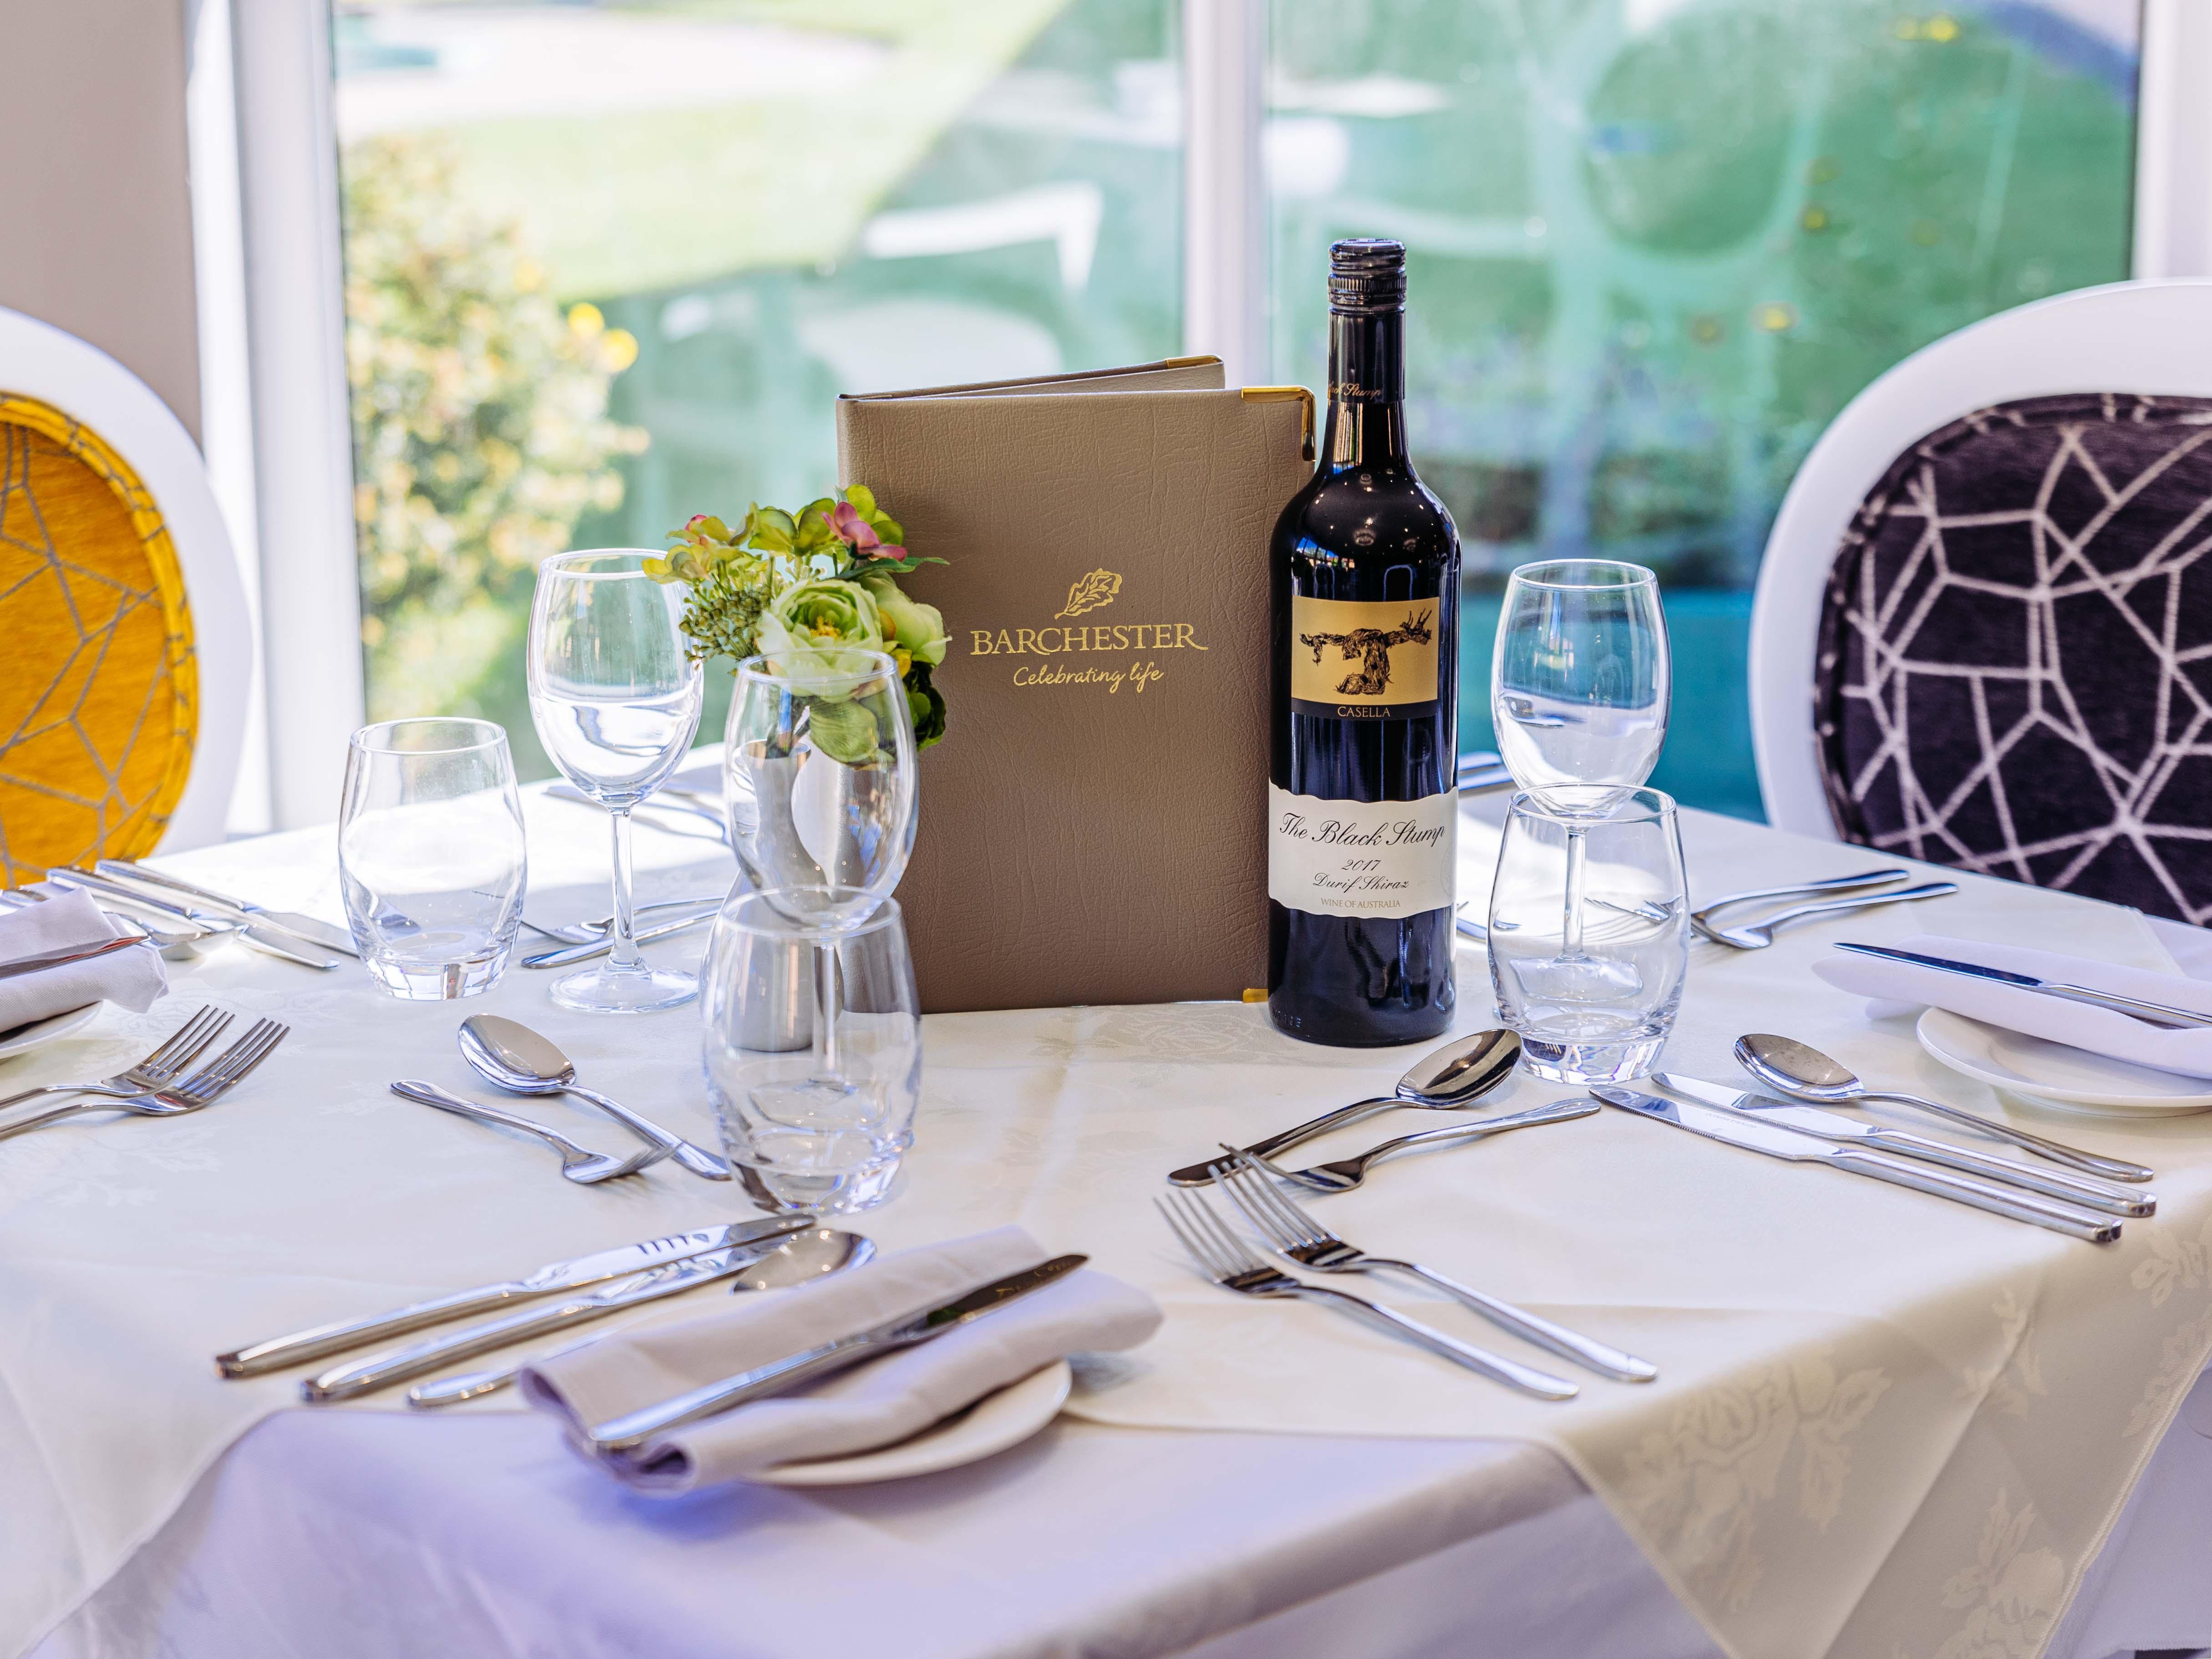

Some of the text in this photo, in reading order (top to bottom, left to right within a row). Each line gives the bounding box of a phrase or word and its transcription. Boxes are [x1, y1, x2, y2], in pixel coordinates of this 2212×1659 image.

[1344, 383, 1381, 400] Stump
[970, 623, 1209, 655] BARCHESTER
[1013, 662, 1164, 693] Celebrating life
[1337, 706, 1390, 718] CASELLA
[1280, 813, 1445, 847] The Black Stump
[1341, 859, 1382, 871] 2017
[1312, 872, 1409, 893] Durif Shiraz
[1321, 898, 1343, 907] WINE
[1357, 900, 1401, 908] AUSTRALIA
